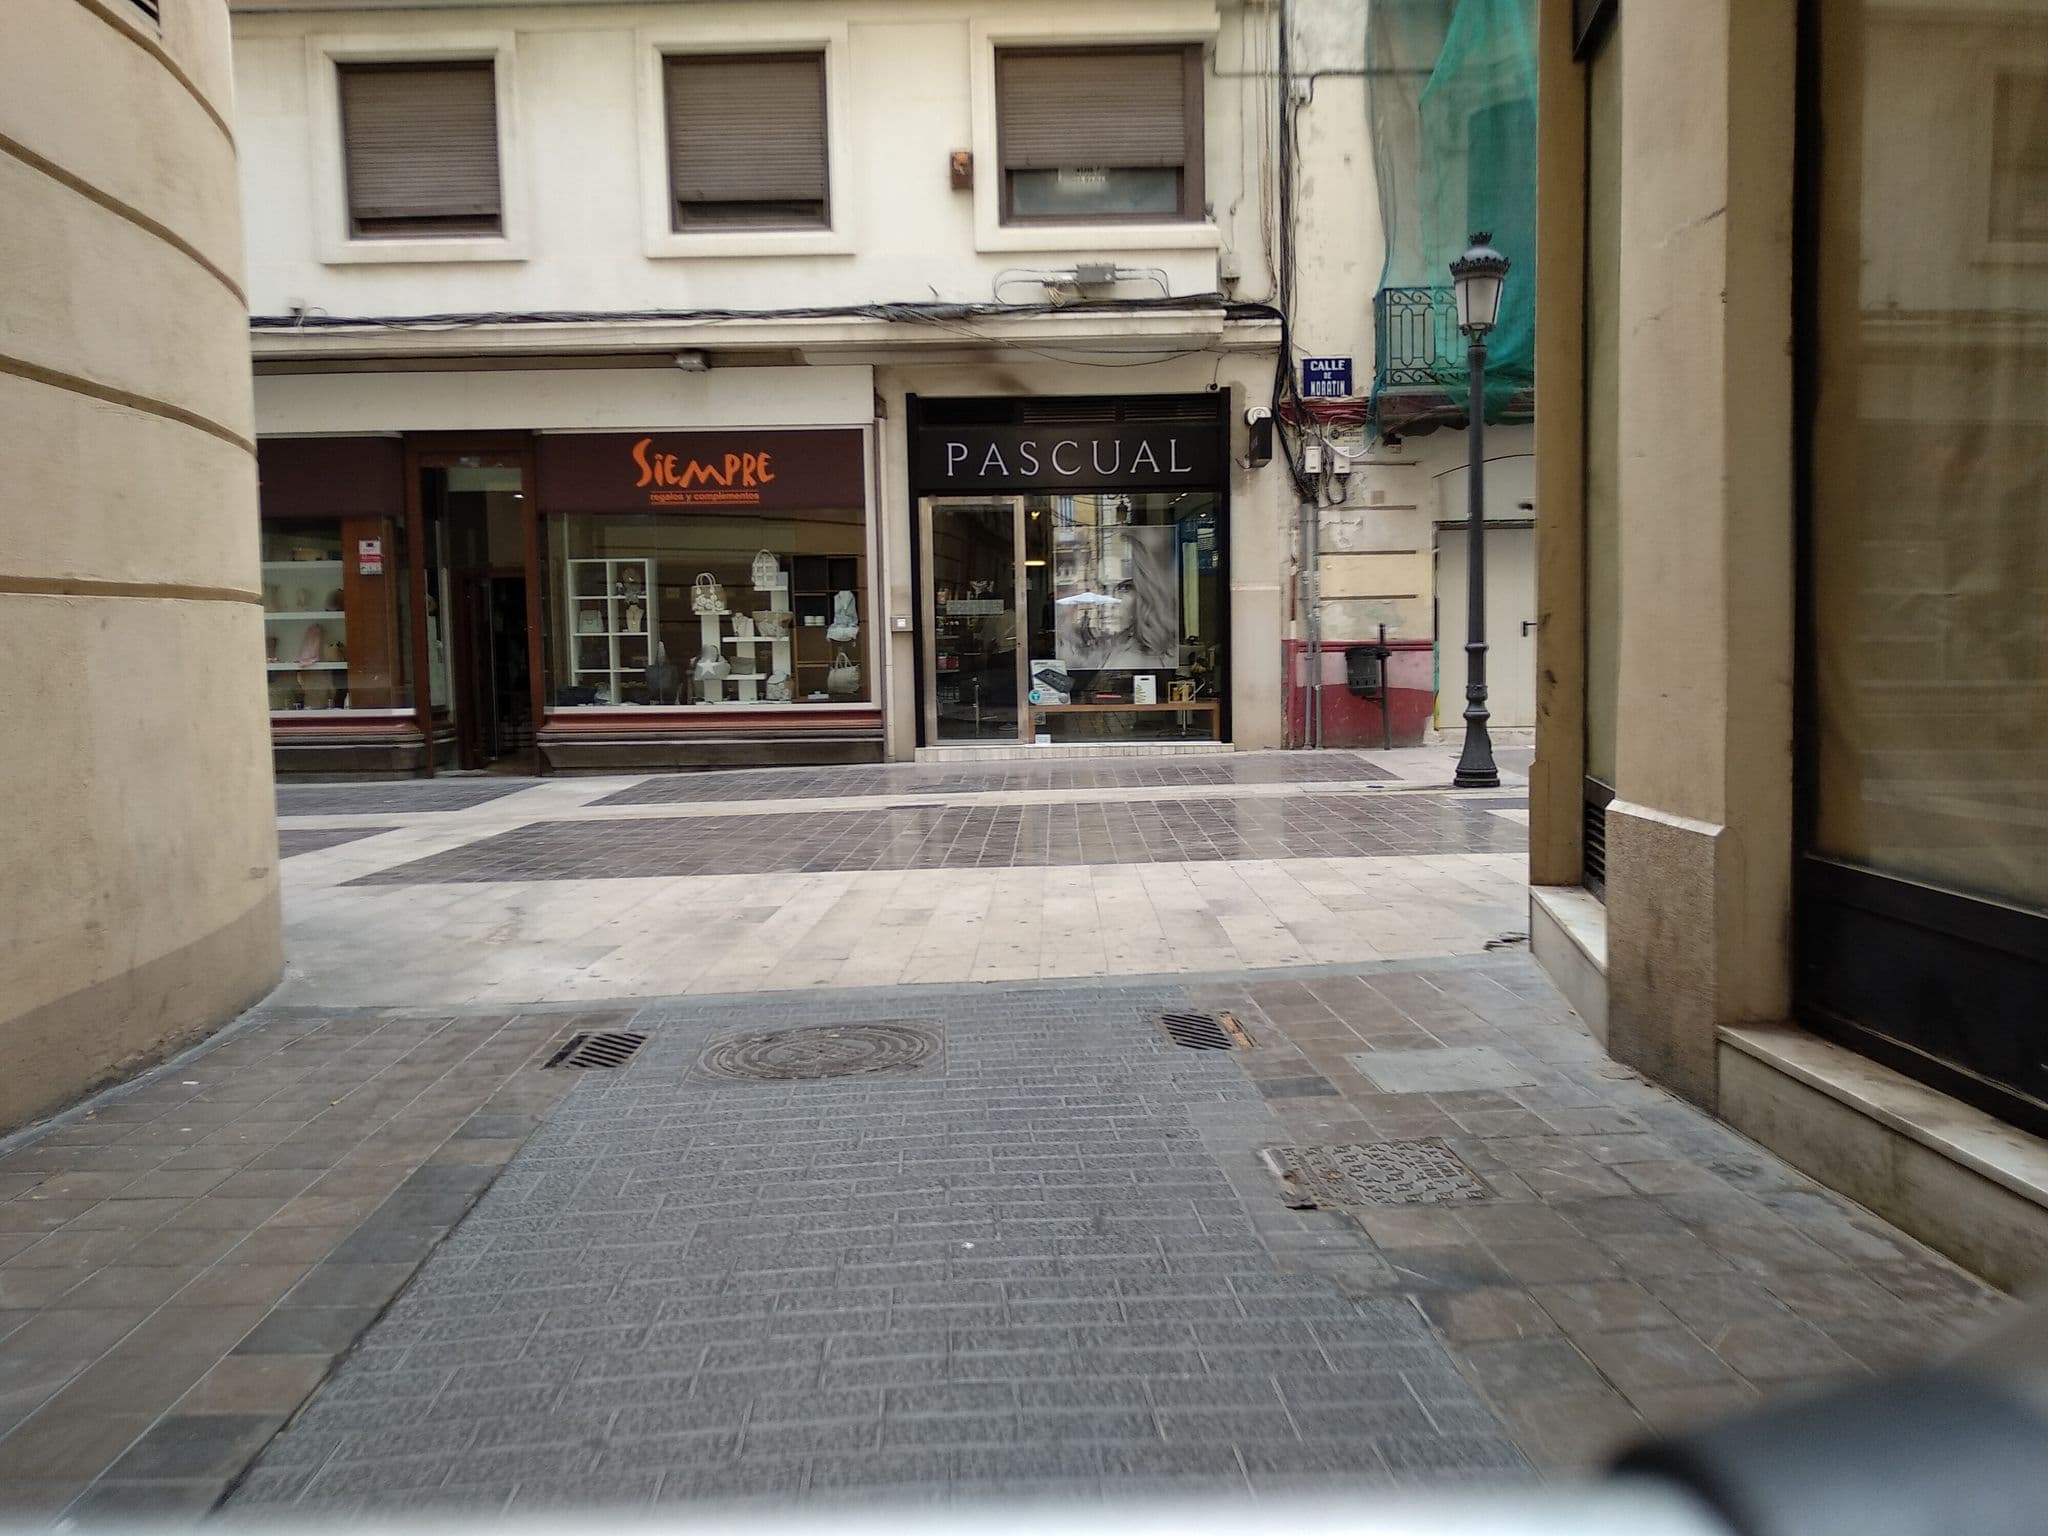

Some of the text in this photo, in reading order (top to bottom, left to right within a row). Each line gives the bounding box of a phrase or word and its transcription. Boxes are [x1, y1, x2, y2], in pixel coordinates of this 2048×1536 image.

[1310, 360, 1345, 371] CALLE
[1323, 371, 1332, 380] DE
[946, 439, 1192, 476] PASCUAL
[693, 491, 760, 502] complementos
